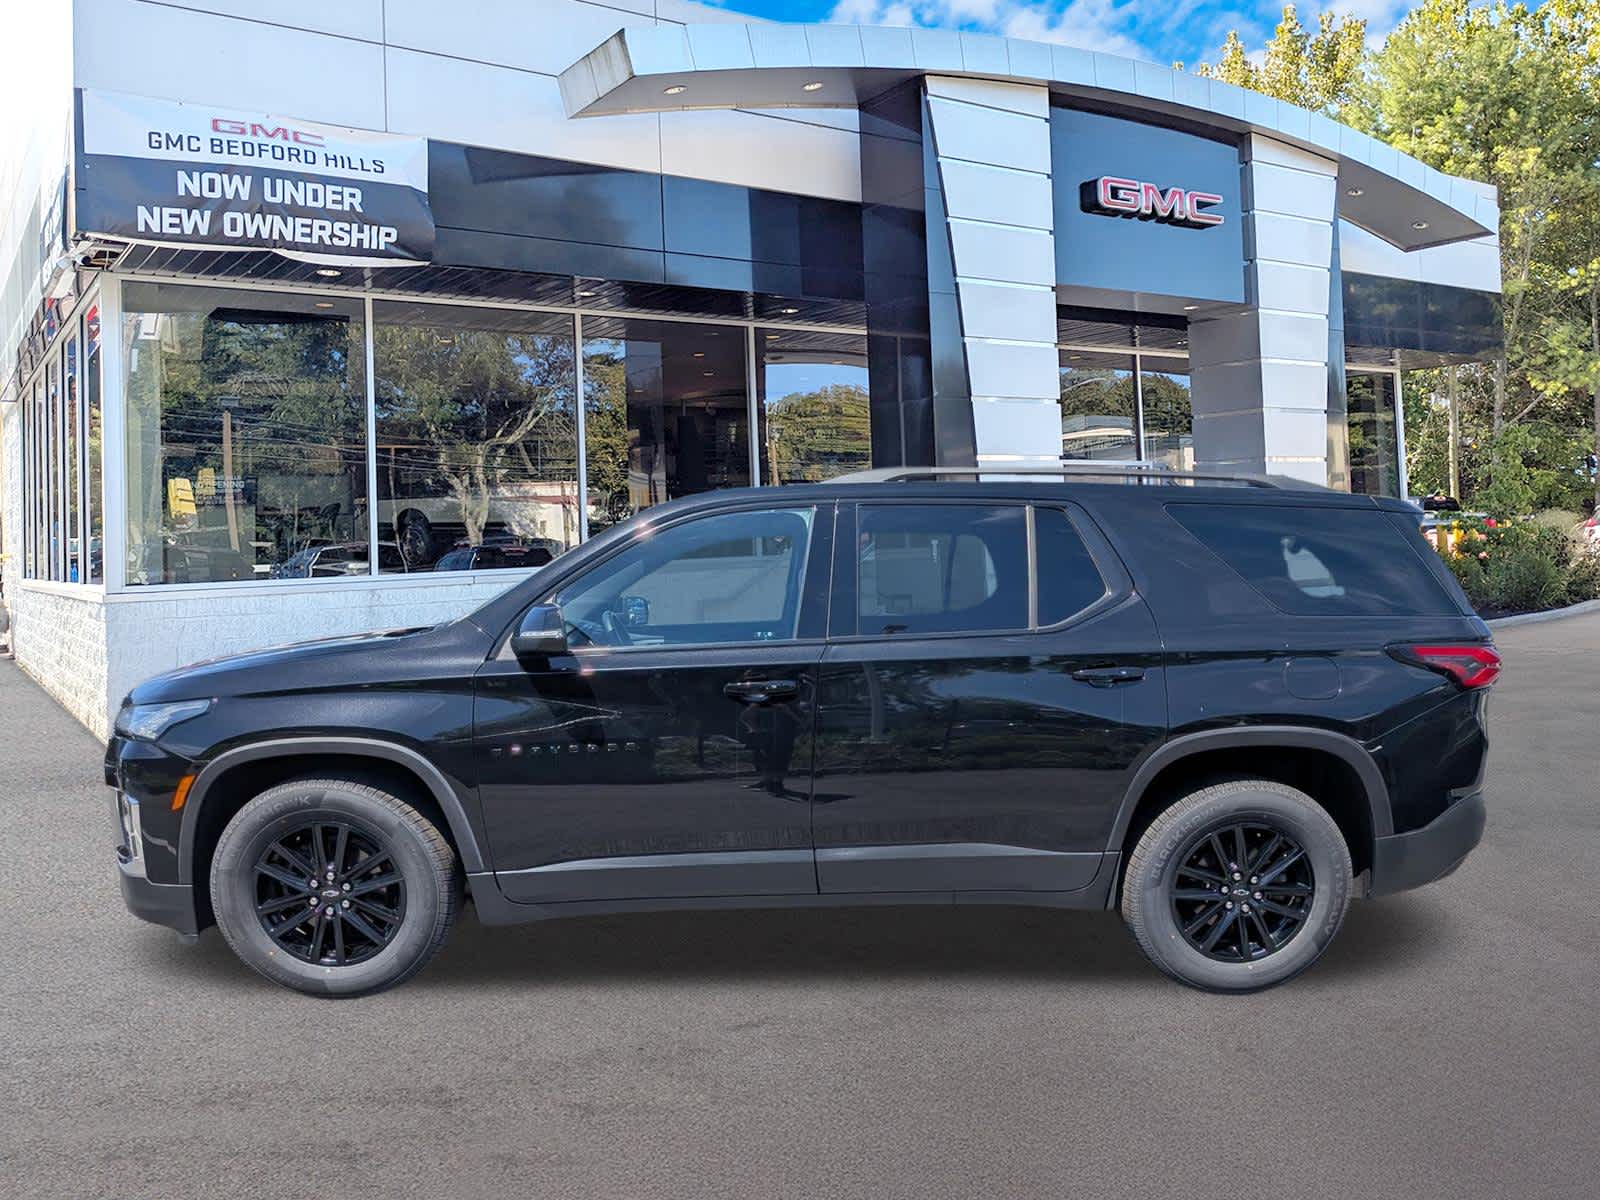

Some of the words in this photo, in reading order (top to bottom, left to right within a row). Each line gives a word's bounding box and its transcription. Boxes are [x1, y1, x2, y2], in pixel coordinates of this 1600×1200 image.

[148, 131, 201, 152] GMC
[210, 138, 316, 165] BEDFORD
[324, 153, 384, 174] HILLS
[211, 118, 326, 148] GMC
[177, 170, 252, 200] NOW
[263, 177, 363, 212] UNDER
[1097, 175, 1225, 225] GMC
[137, 205, 211, 235] NEW
[223, 211, 398, 250] OWNERSHIP
